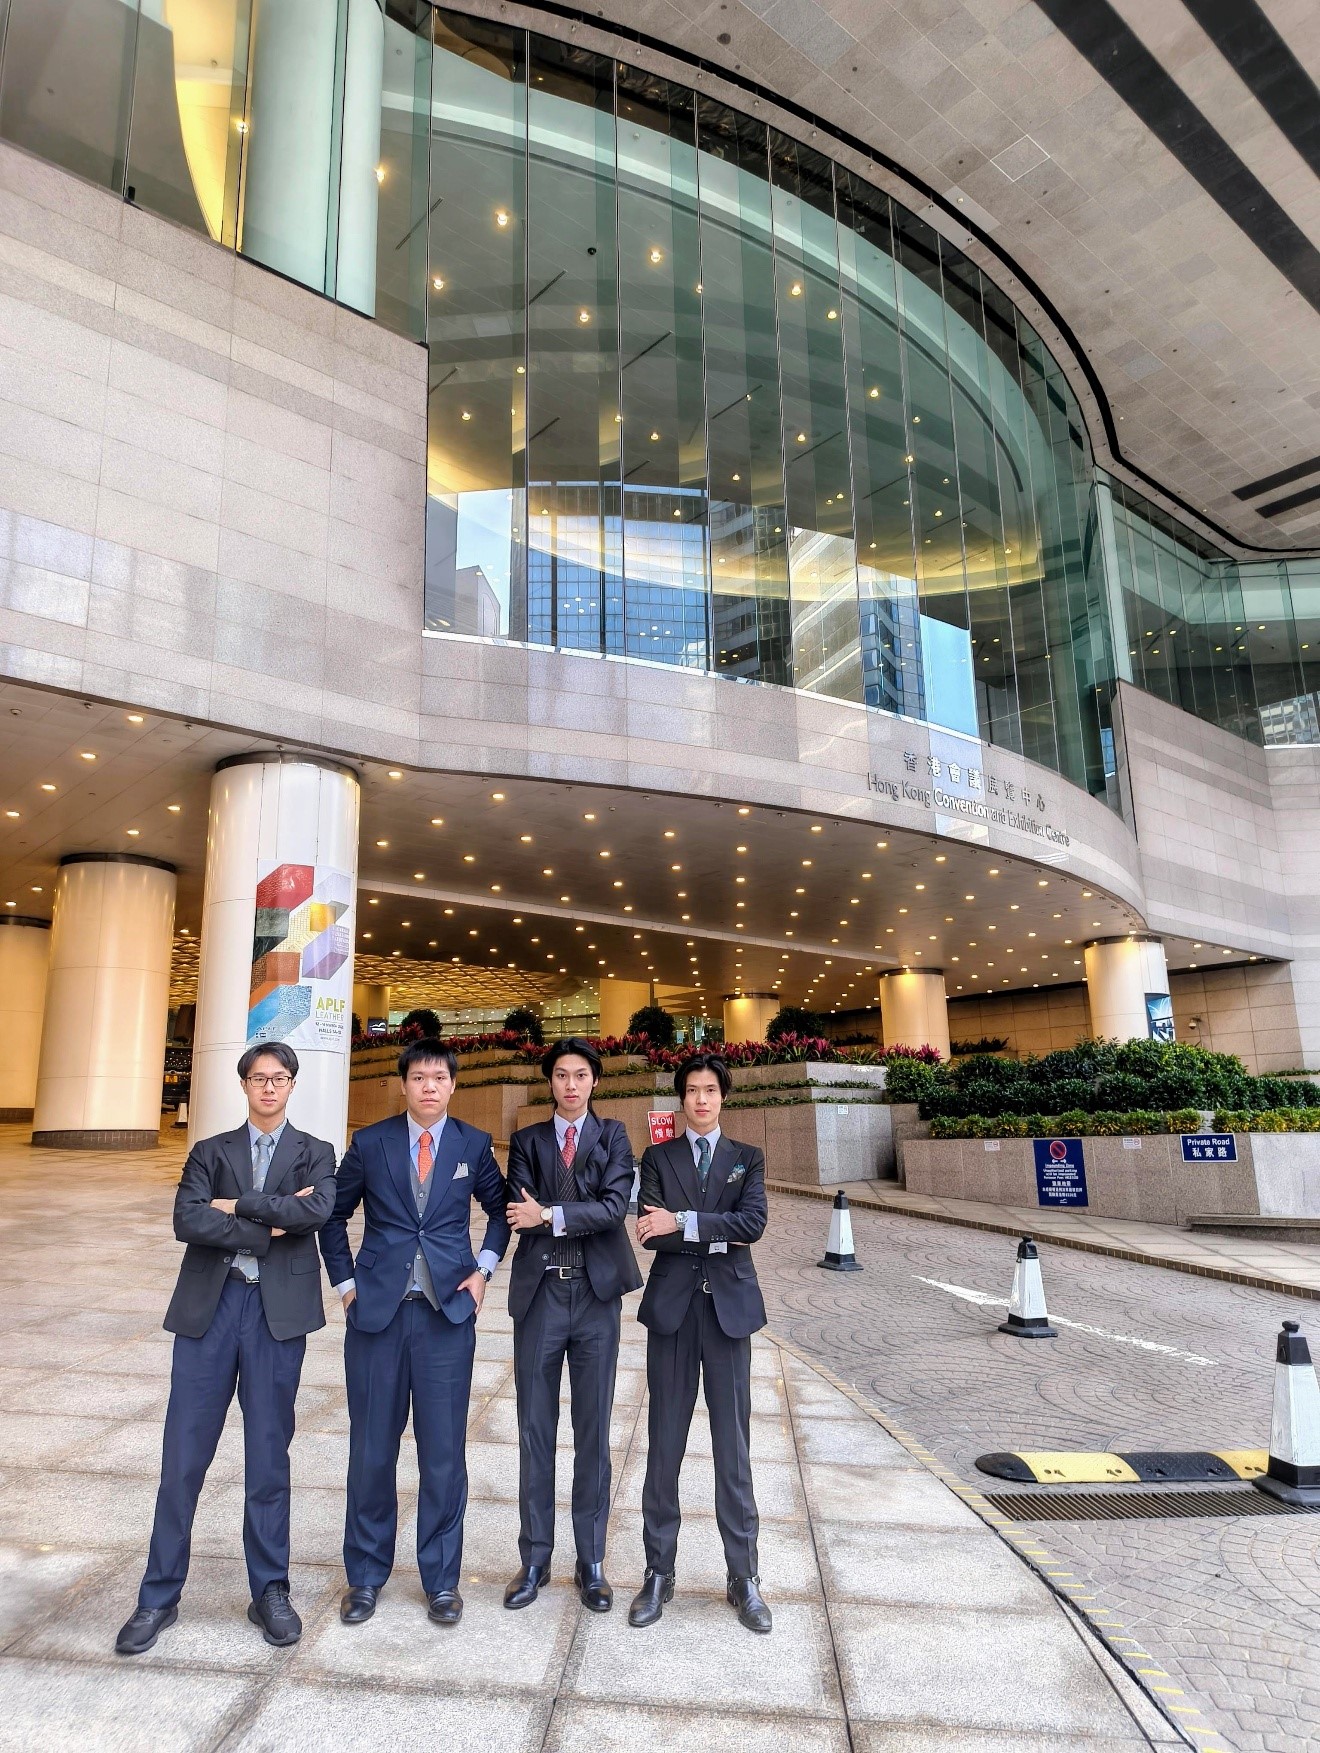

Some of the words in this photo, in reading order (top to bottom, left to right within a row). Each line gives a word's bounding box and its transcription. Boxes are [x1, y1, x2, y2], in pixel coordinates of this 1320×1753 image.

[903, 751, 1045, 812] 香港會議展覽中心
[867, 772, 899, 801] Hong
[901, 780, 931, 808] Kong
[933, 787, 989, 819] Convention
[990, 808, 1006, 825] and
[1007, 810, 1044, 838] Exhibition
[1045, 824, 1070, 847] Centre
[315, 996, 346, 1013] APLF
[651, 1116, 673, 1126] SLOW
[1211, 1138, 1230, 1146] Road
[1192, 1147, 1227, 1158] 私家路
